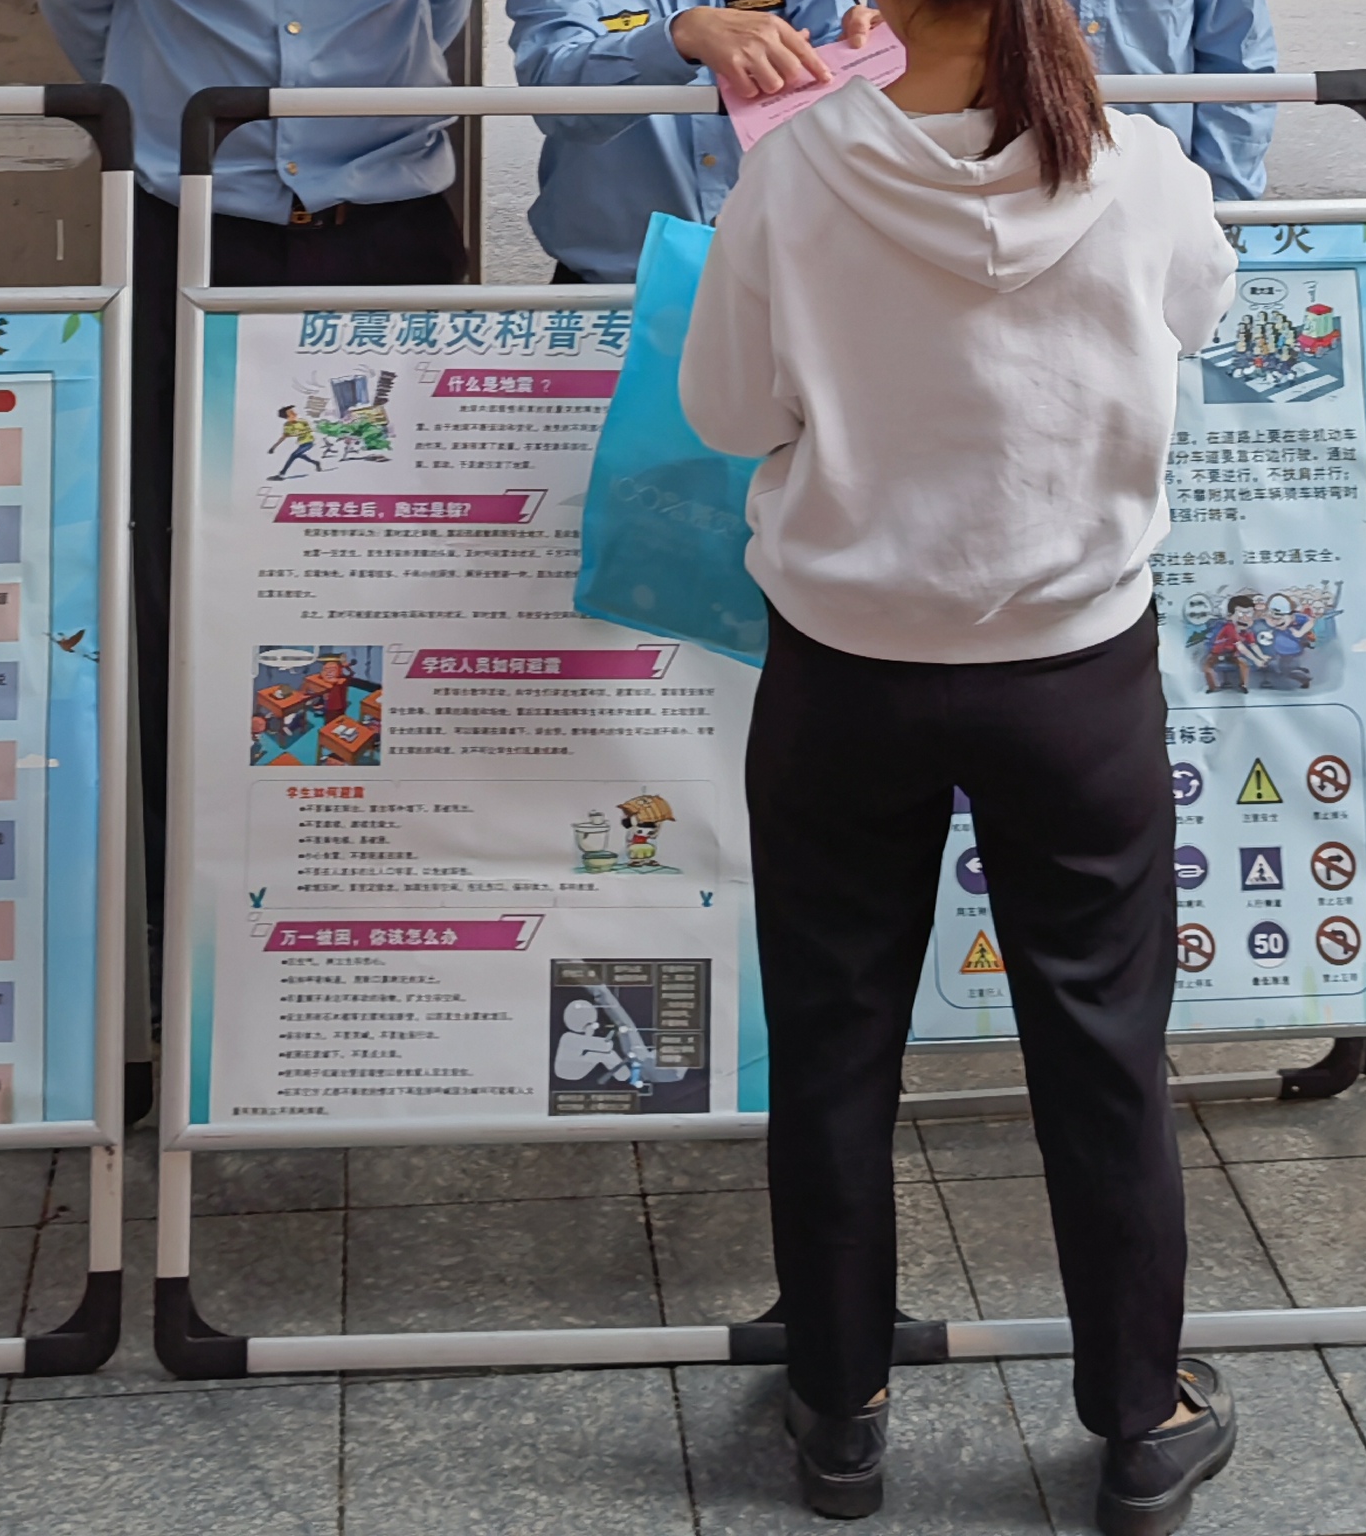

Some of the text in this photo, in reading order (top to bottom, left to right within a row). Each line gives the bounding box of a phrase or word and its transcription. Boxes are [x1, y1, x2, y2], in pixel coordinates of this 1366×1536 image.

[297, 310, 632, 350] 防震减灾科普专
[421, 656, 561, 675] 学校人员如何避震
[1254, 933, 1284, 955] 50
